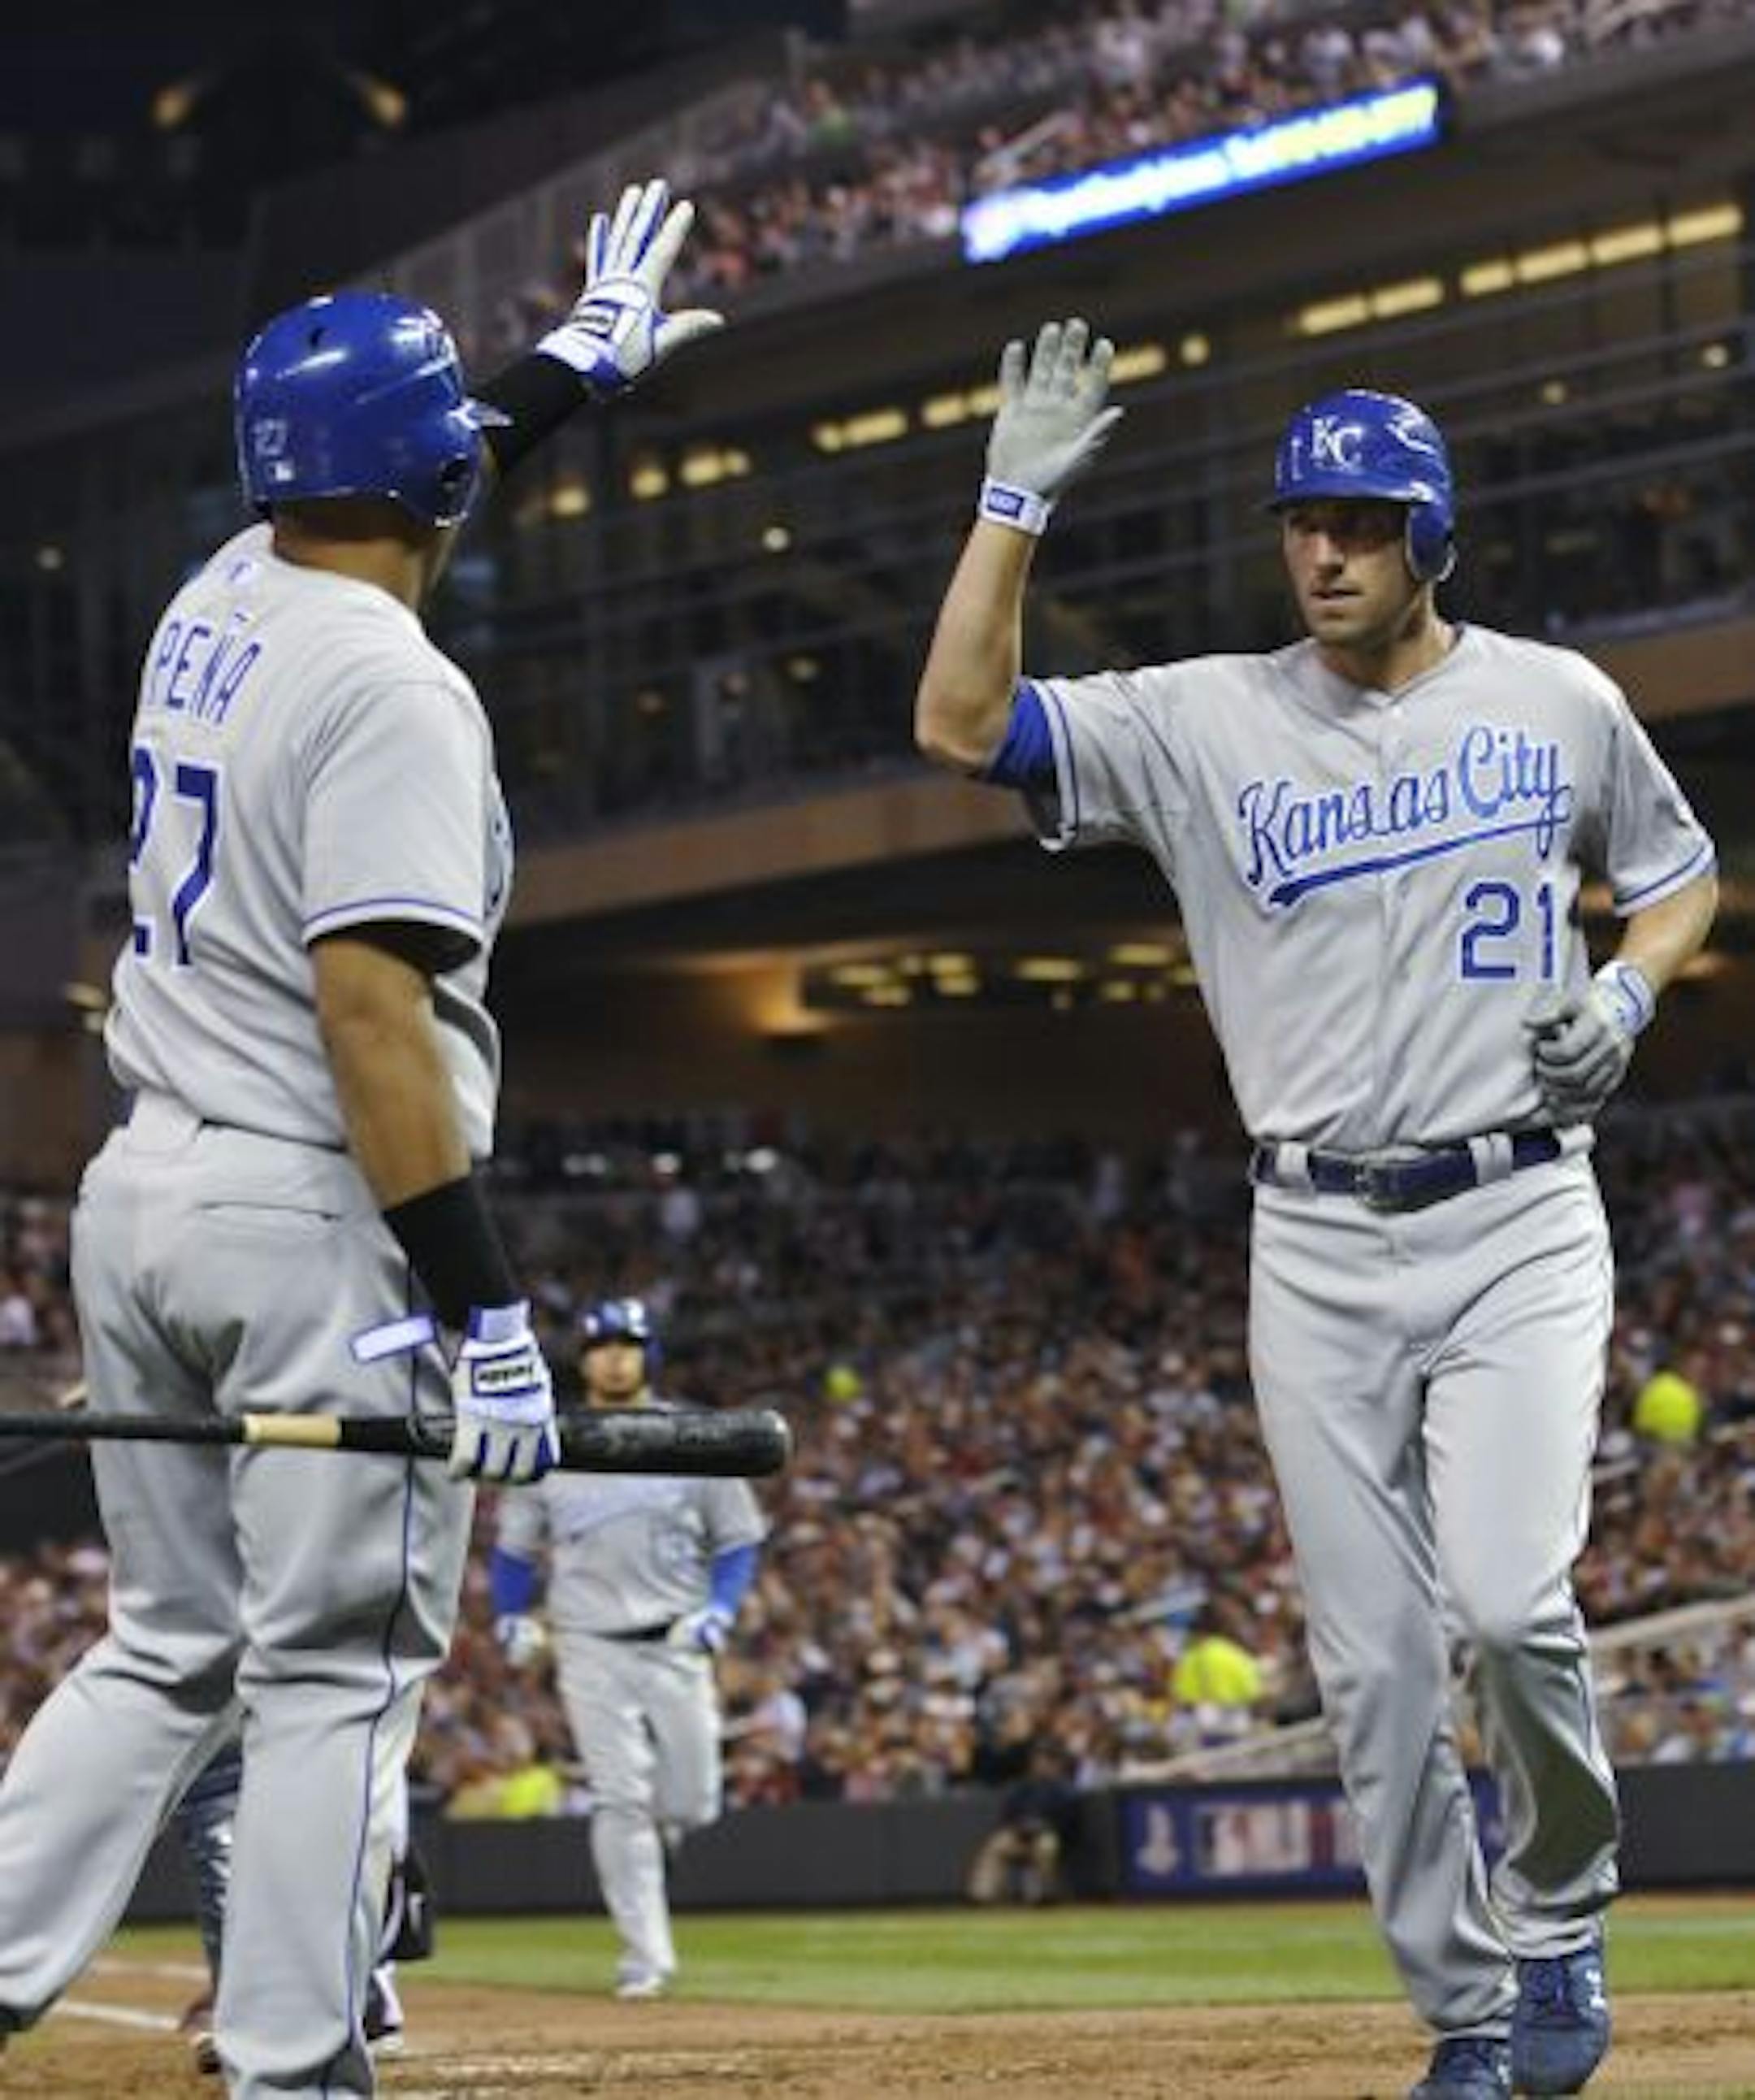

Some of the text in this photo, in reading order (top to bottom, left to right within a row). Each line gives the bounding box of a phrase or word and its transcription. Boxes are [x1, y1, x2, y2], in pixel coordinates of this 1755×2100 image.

[1311, 415, 1364, 471] KC
[148, 613, 261, 724] PEÑA
[1237, 726, 1571, 887] Kansas City
[1462, 882, 1554, 979] 21
